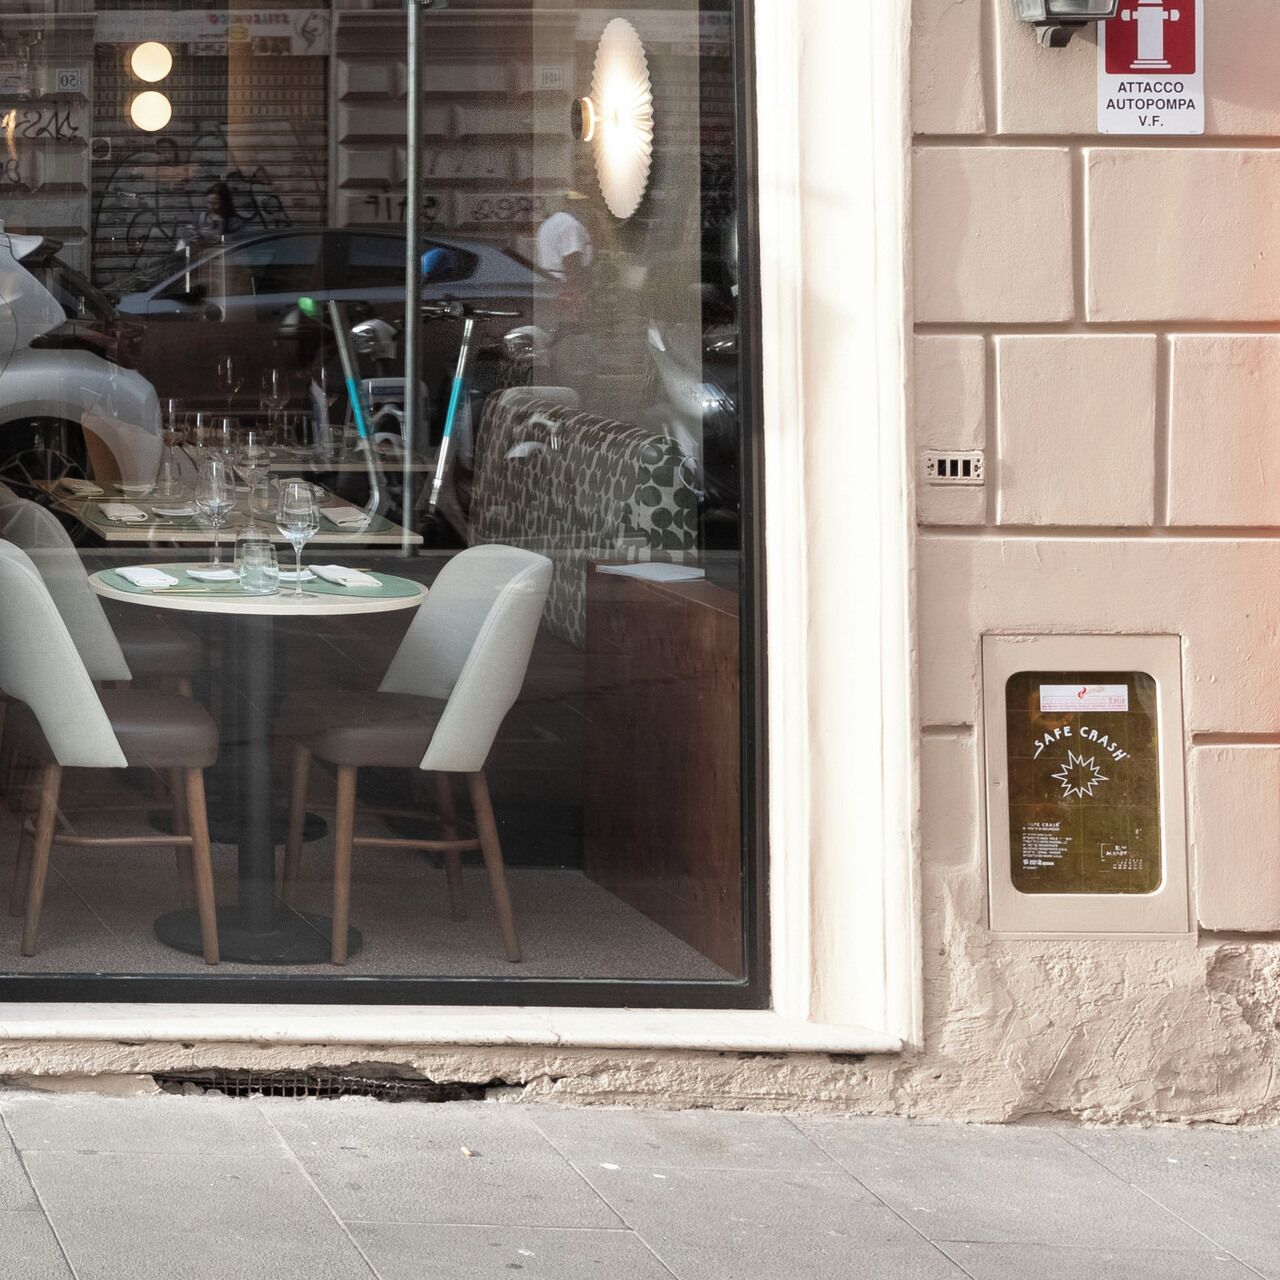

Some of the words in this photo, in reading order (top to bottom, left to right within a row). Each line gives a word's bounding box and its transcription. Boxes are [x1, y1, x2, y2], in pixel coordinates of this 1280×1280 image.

[1117, 81, 1184, 93] ATTACCO
[1106, 98, 1196, 110] AUTOPOMPA
[1138, 115, 1164, 127] V.F.
[1033, 726, 1073, 760] SAFE
[1080, 726, 1127, 762] CRASH
